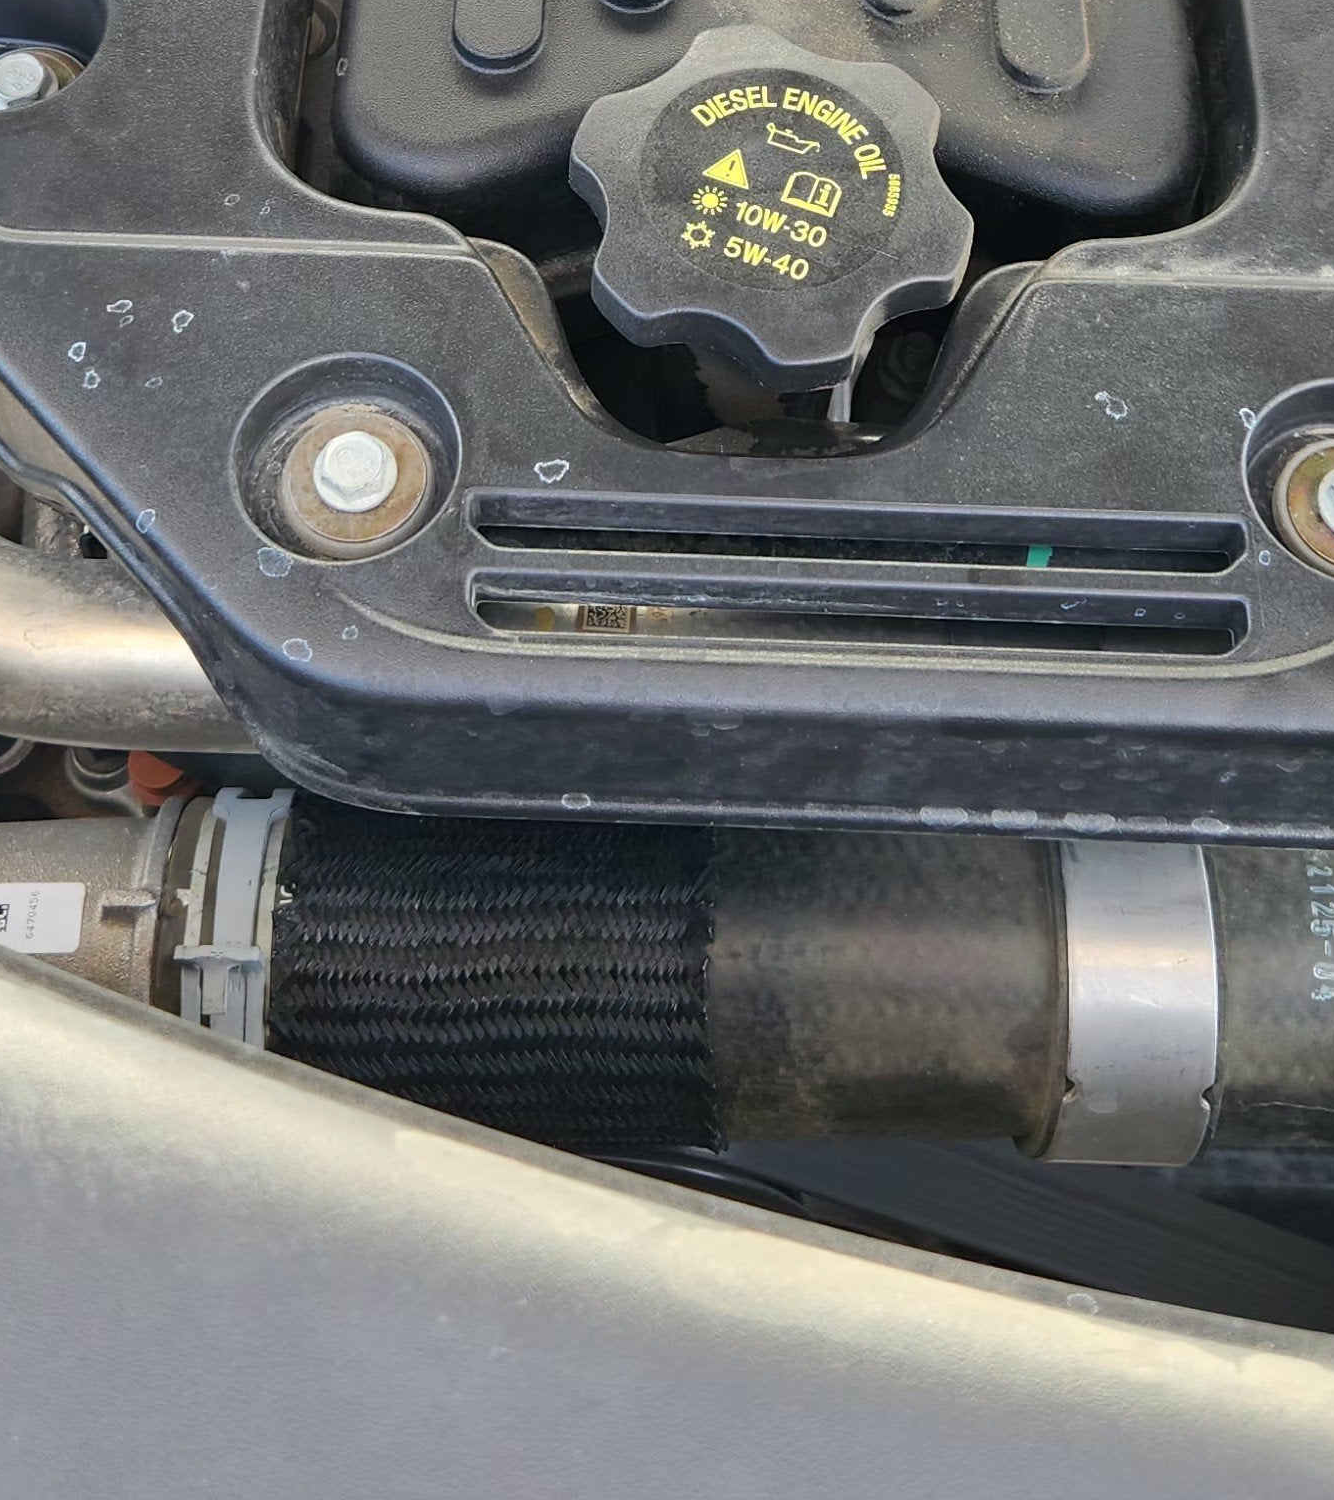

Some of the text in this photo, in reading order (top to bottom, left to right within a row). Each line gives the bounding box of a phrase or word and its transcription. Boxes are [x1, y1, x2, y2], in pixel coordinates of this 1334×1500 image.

[691, 86, 887, 180] DIESEL ENGINE OIL
[735, 201, 827, 248] 10W-30
[723, 235, 809, 280] 5W-40
[24, 889, 40, 940] 6470456
